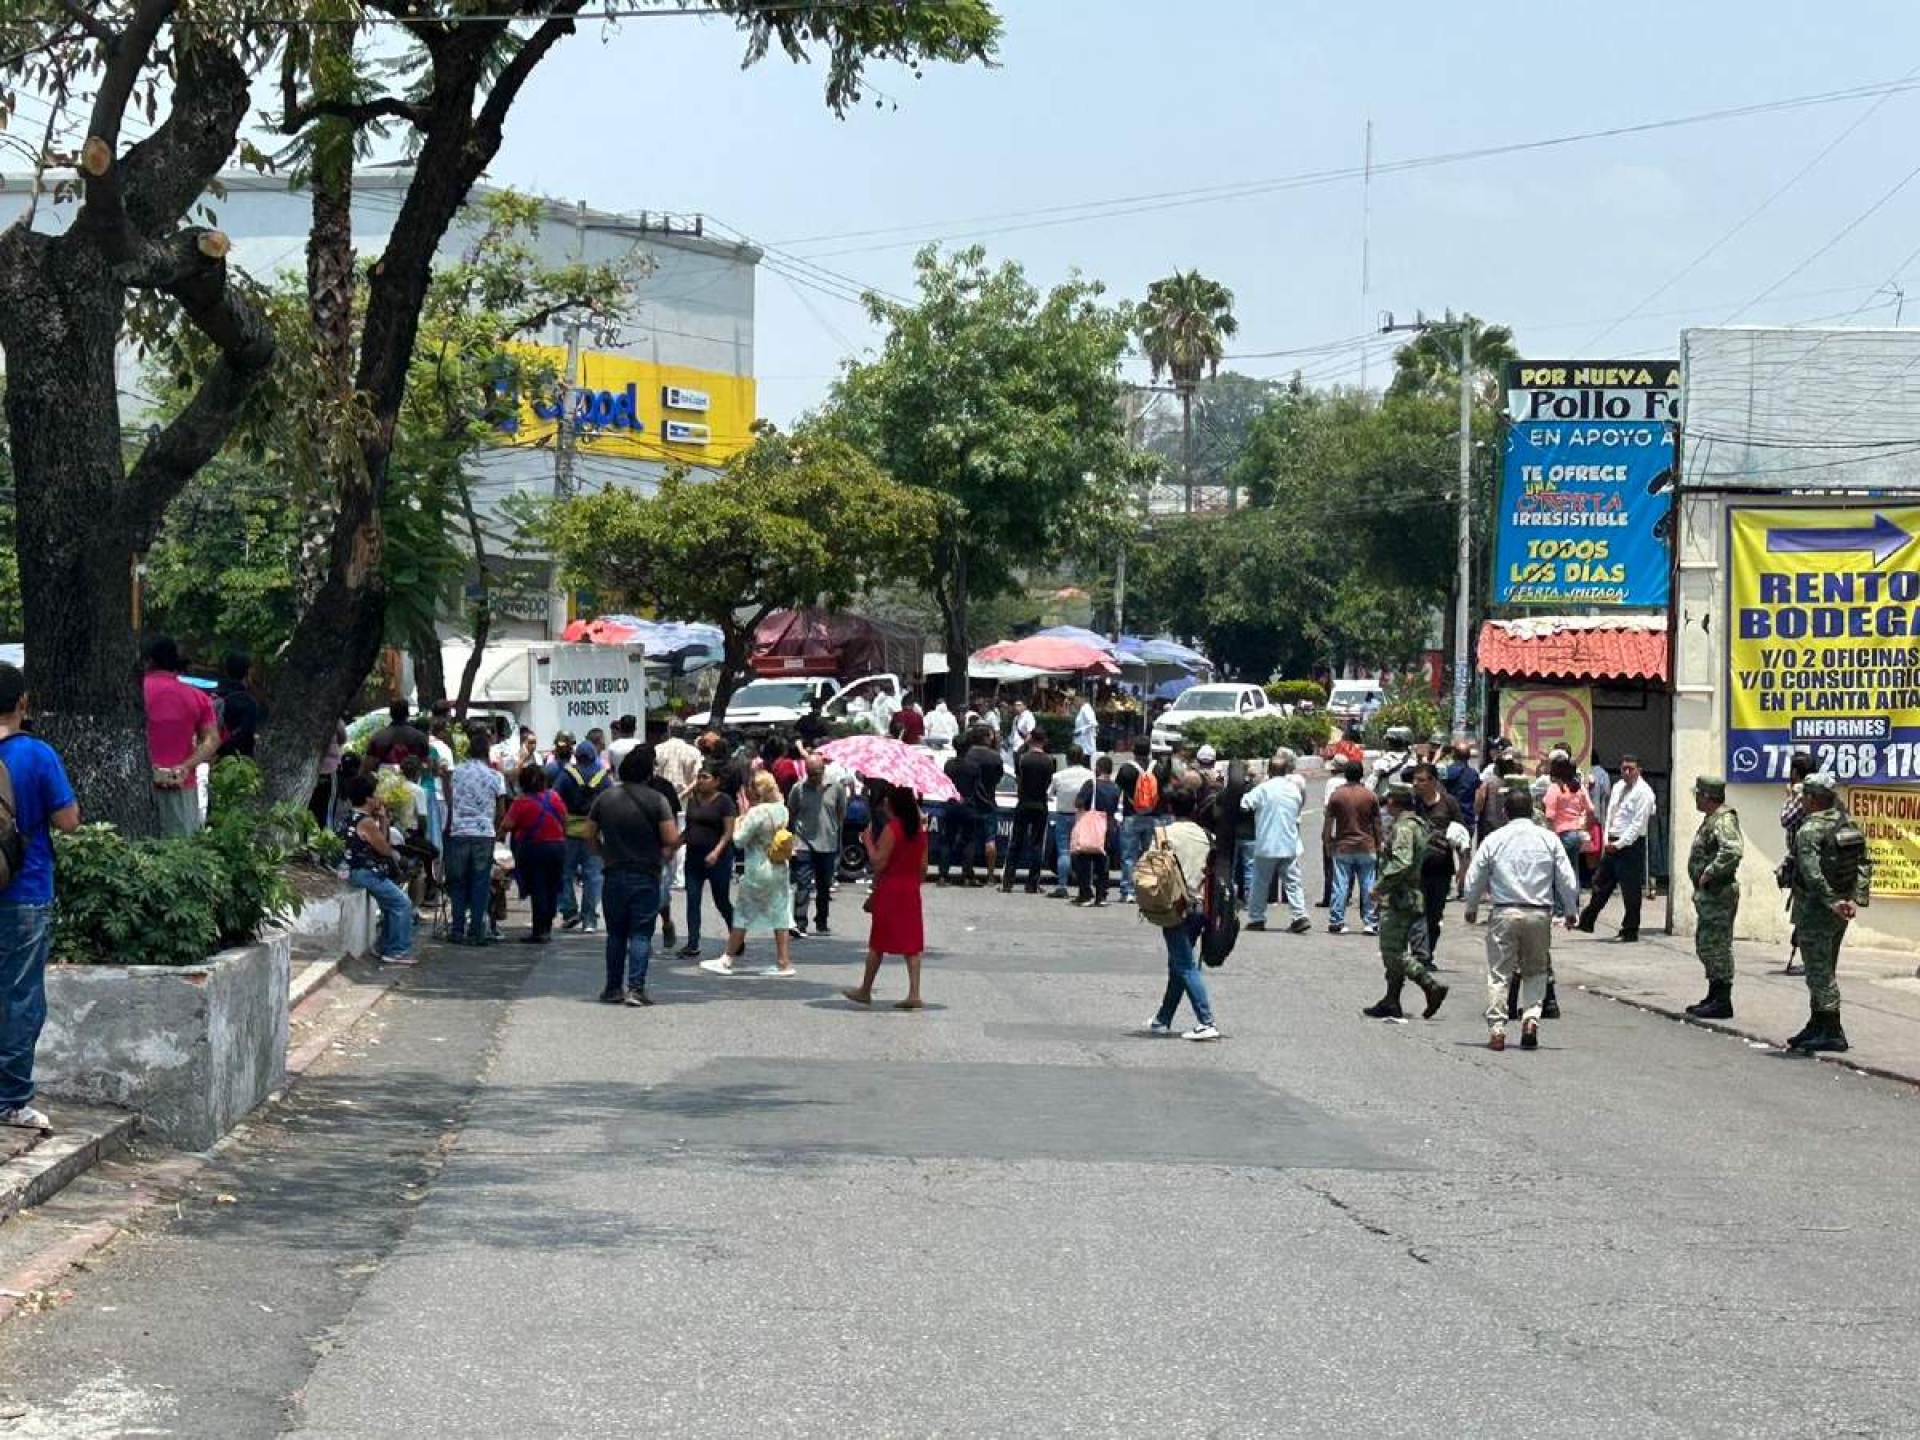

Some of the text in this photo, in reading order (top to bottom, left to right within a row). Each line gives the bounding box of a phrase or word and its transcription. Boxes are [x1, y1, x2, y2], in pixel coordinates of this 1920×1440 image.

[1521, 368, 1566, 386] POR
[1574, 367, 1653, 386] NUEVA
[1530, 390, 1631, 419] Pollo
[1531, 429, 1560, 446] EN
[1568, 429, 1651, 446] APOYO
[1521, 465, 1628, 481] TE OFRECE
[1512, 512, 1628, 526] IRRESISTIBLE
[1527, 539, 1609, 559] TODOS
[1511, 559, 1625, 582] LOS DÍAS
[1760, 572, 1920, 603] RENTO
[1739, 606, 1920, 639] BODEG
[1761, 647, 1920, 668] Y/O 2 OFICINAS
[550, 677, 629, 696] SERVICIO MEDICO
[1739, 669, 1775, 689] Y/O
[568, 700, 609, 717] FORENSE
[1760, 690, 1920, 711] EN PLANTA ALTA
[1796, 719, 1886, 737] INFORMES
[1817, 743, 1877, 779] 268
